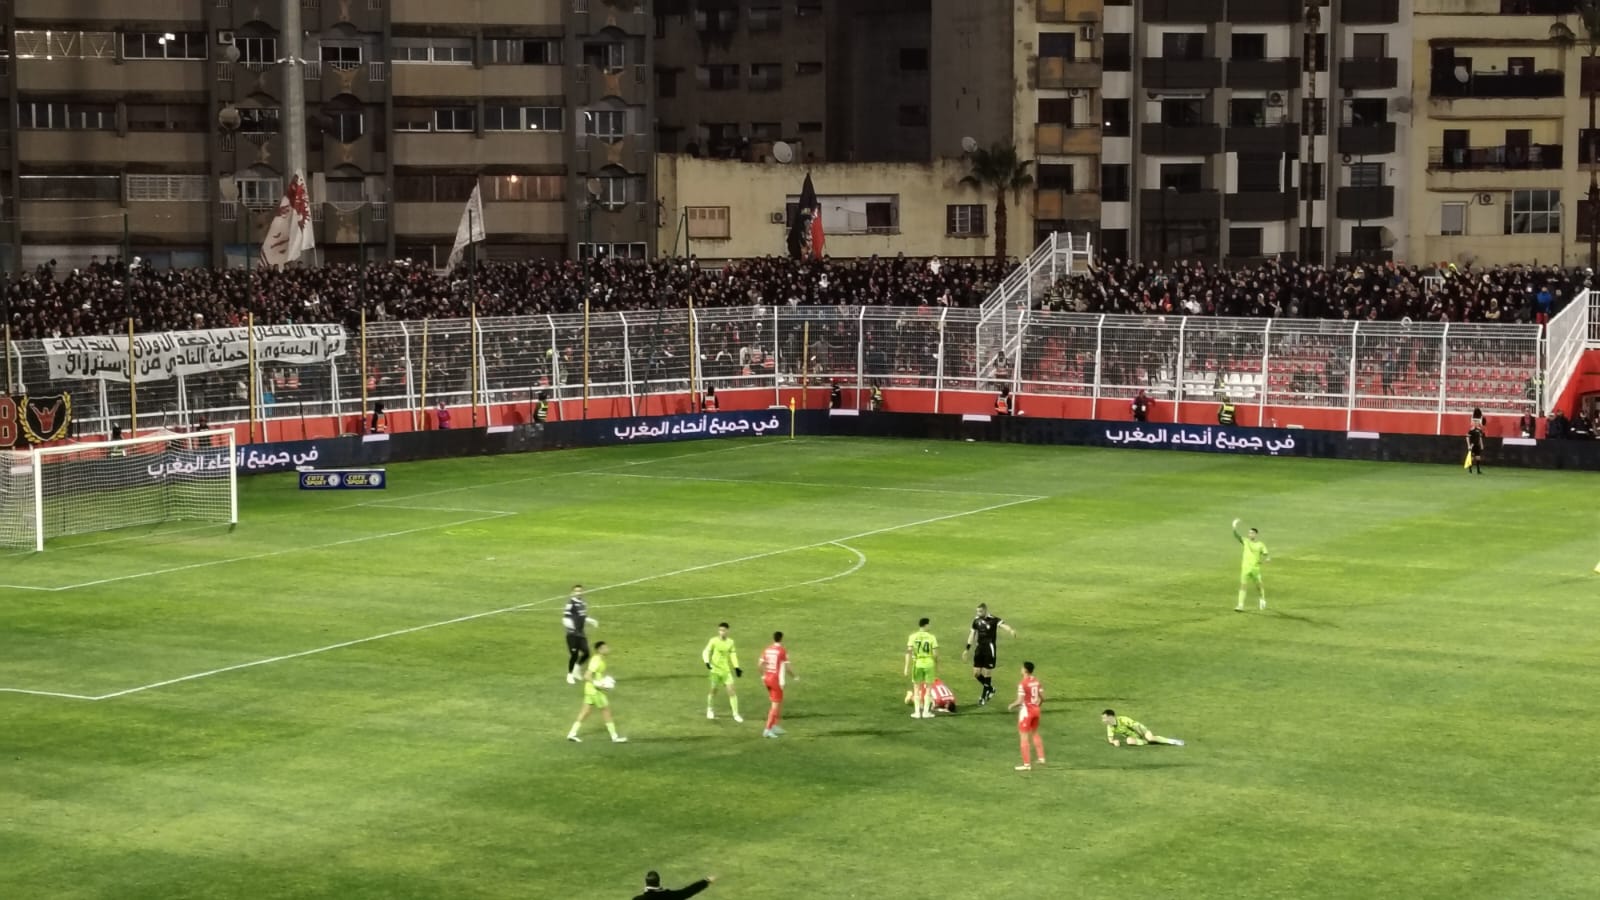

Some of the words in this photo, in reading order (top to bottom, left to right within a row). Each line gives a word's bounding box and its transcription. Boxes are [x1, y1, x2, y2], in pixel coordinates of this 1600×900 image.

[614, 420, 669, 440] المغرب
[672, 415, 707, 434] أنحاء
[709, 418, 749, 434] جميع
[751, 415, 780, 436] في
[1105, 426, 1167, 444] المغرب
[1171, 427, 1212, 445] أنحاء
[1215, 431, 1263, 449] جميع
[1266, 434, 1296, 455] في
[247, 450, 290, 468] جميع
[293, 446, 319, 465] في
[915, 640, 930, 653] 74
